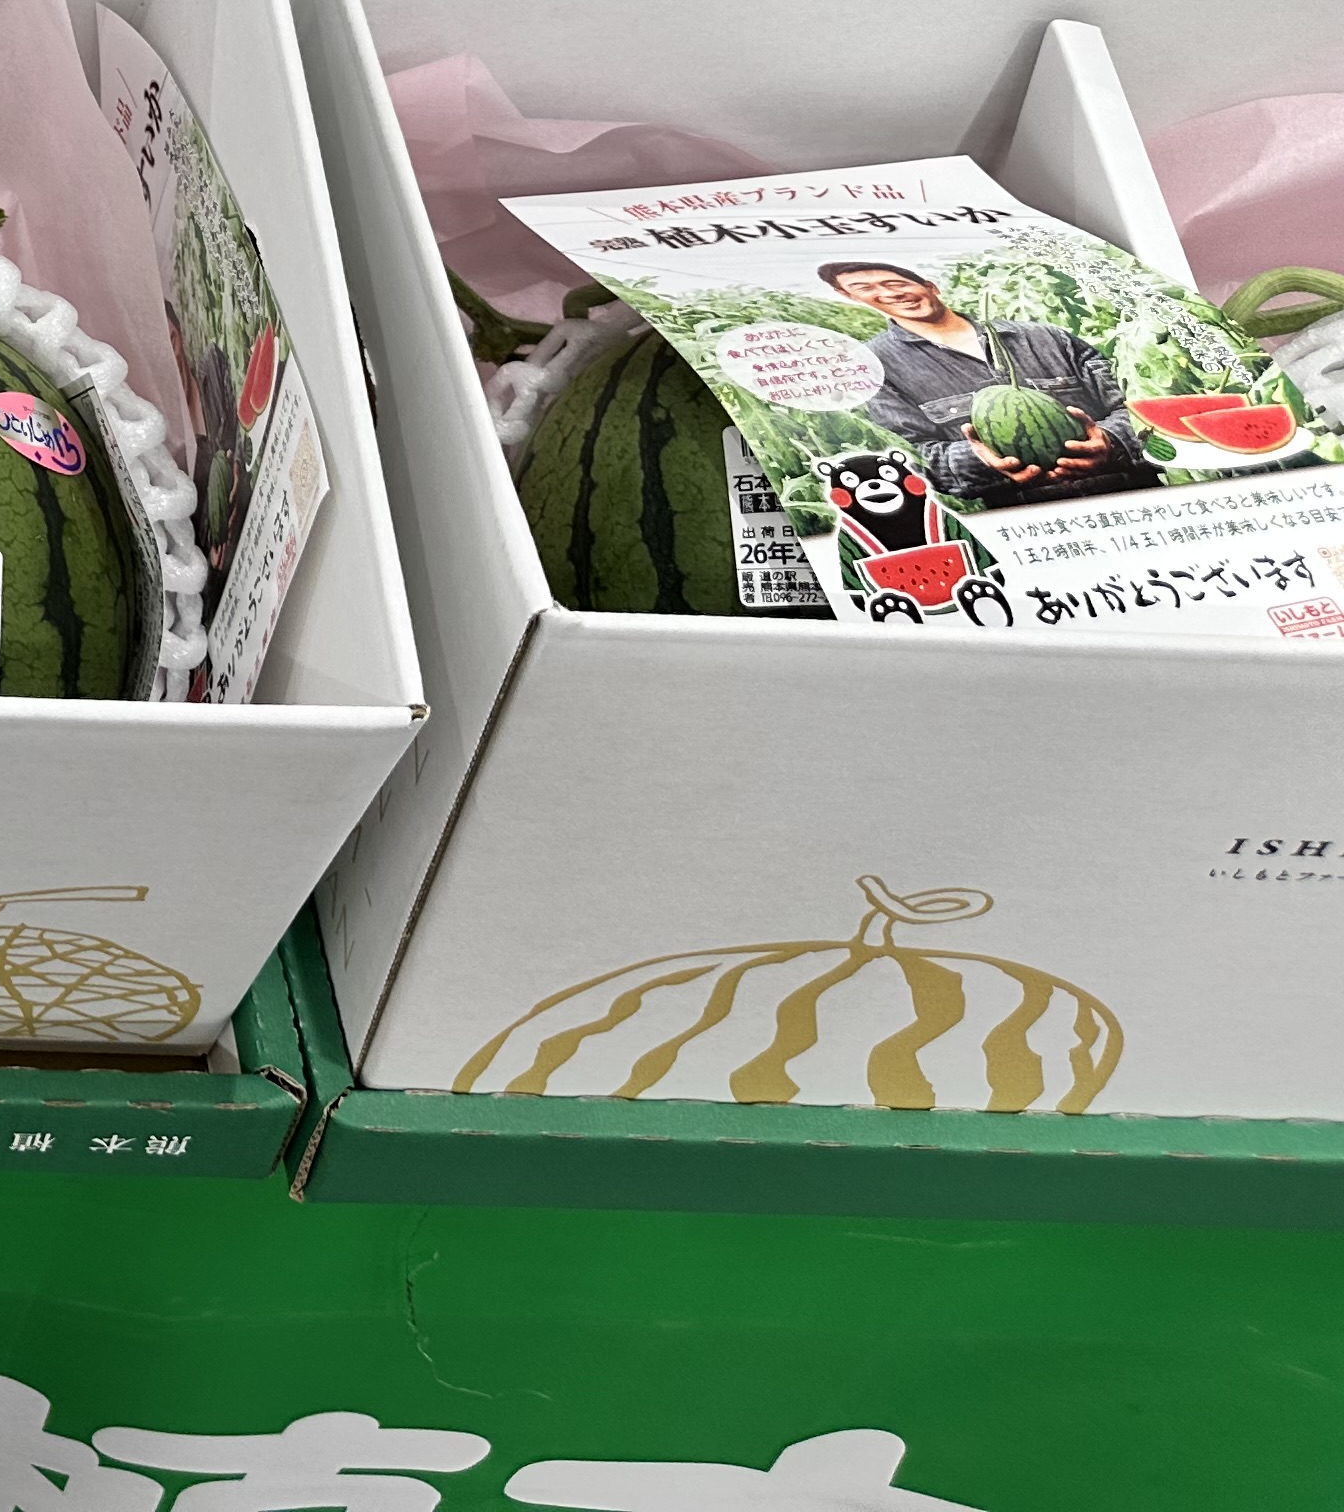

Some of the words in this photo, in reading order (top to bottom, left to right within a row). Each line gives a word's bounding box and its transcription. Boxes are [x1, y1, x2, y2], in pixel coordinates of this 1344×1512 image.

[623, 182, 906, 223] 熊本県産ブランド品
[646, 206, 1014, 251] 植木小玉すいか
[742, 525, 795, 539] 出荷日
[1025, 550, 1316, 625] ありがとうございます
[1273, 601, 1335, 624] いしもと
[1225, 838, 1344, 857] ISH
[89, 1133, 193, 1157] 熊本
